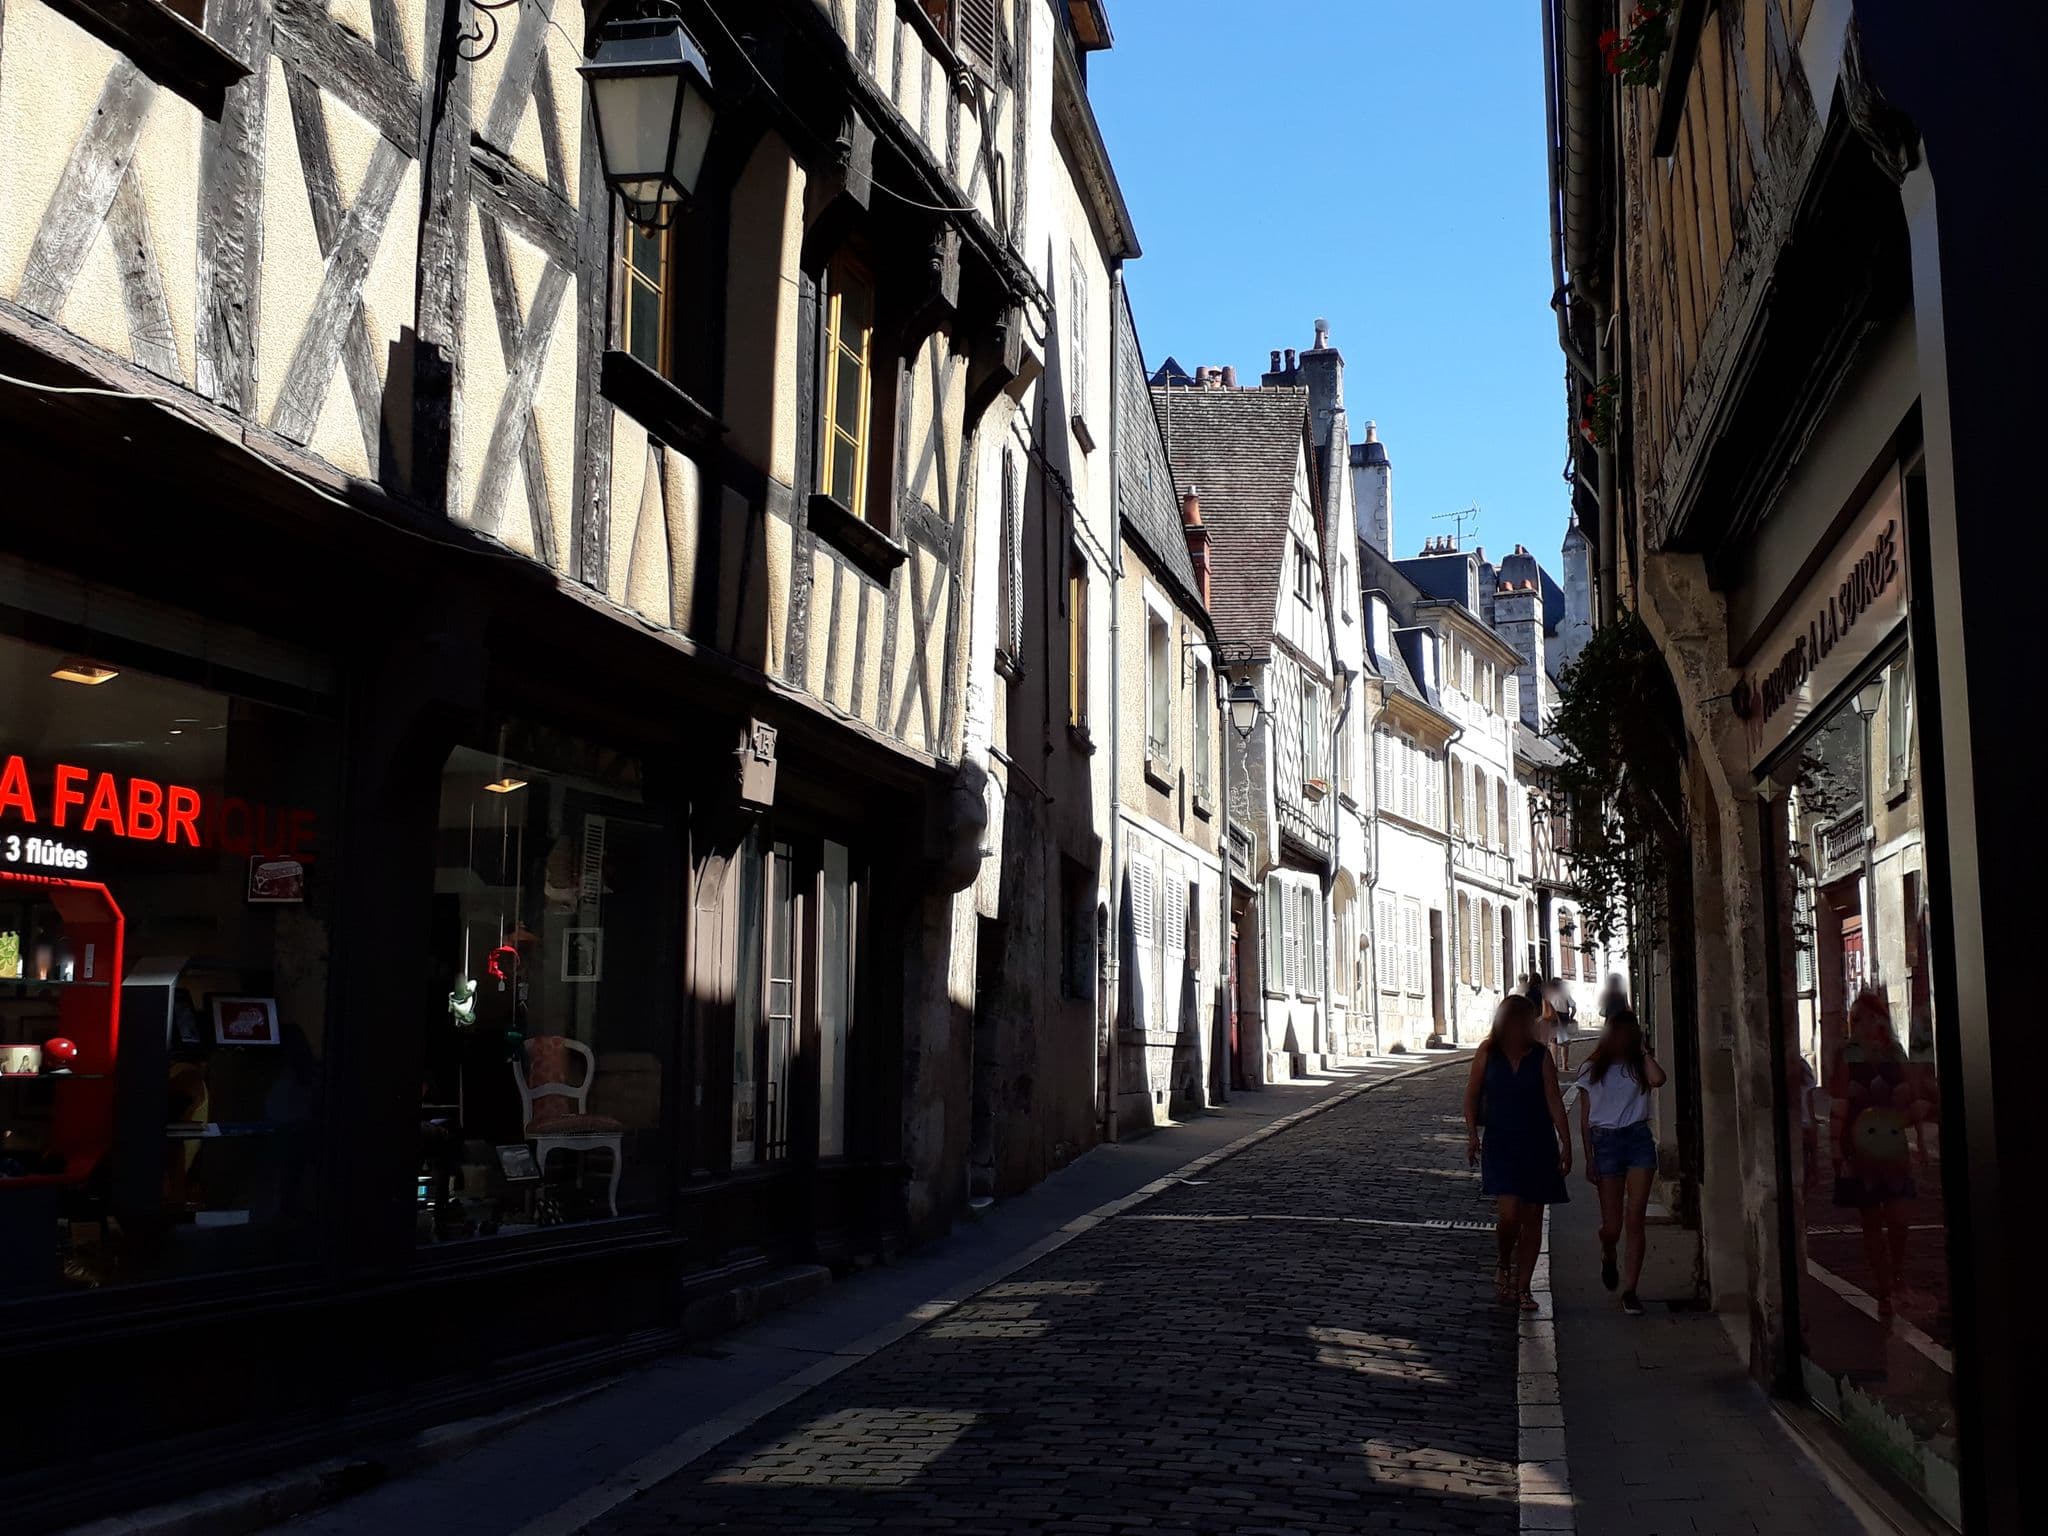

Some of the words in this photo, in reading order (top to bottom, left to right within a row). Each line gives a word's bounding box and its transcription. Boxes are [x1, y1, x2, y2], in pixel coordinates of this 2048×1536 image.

[1840, 519, 1896, 636] SOURCE
[5, 834, 21, 863] 3
[25, 836, 89, 871] flûtes
